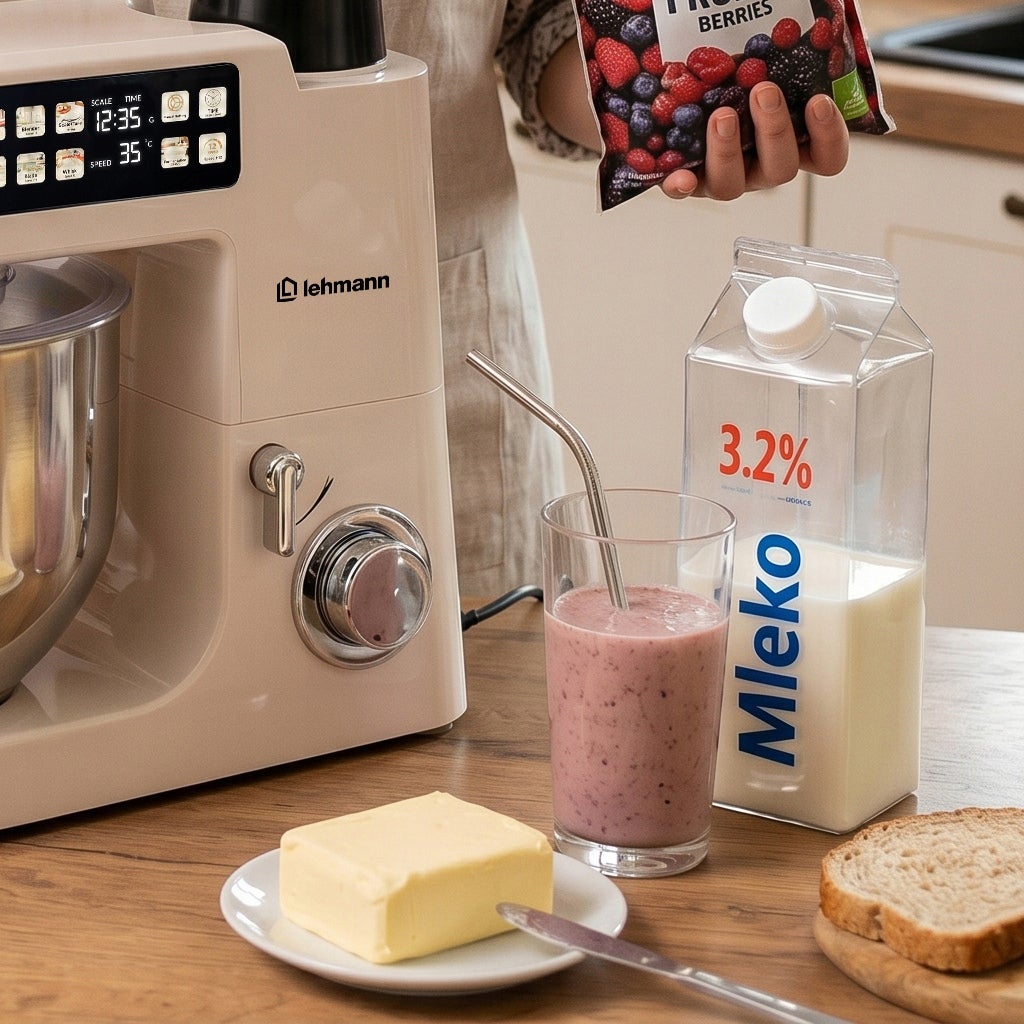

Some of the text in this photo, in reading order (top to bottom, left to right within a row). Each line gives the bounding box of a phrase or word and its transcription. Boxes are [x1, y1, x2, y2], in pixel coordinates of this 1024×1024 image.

[91, 94, 142, 107] SCALE TIME
[96, 106, 141, 132] 12:35
[90, 159, 112, 169] SPEED
[119, 141, 141, 165] 35
[303, 275, 390, 297] lehmann
[719, 423, 812, 490] 3.2%
[734, 533, 802, 767] Mleko
